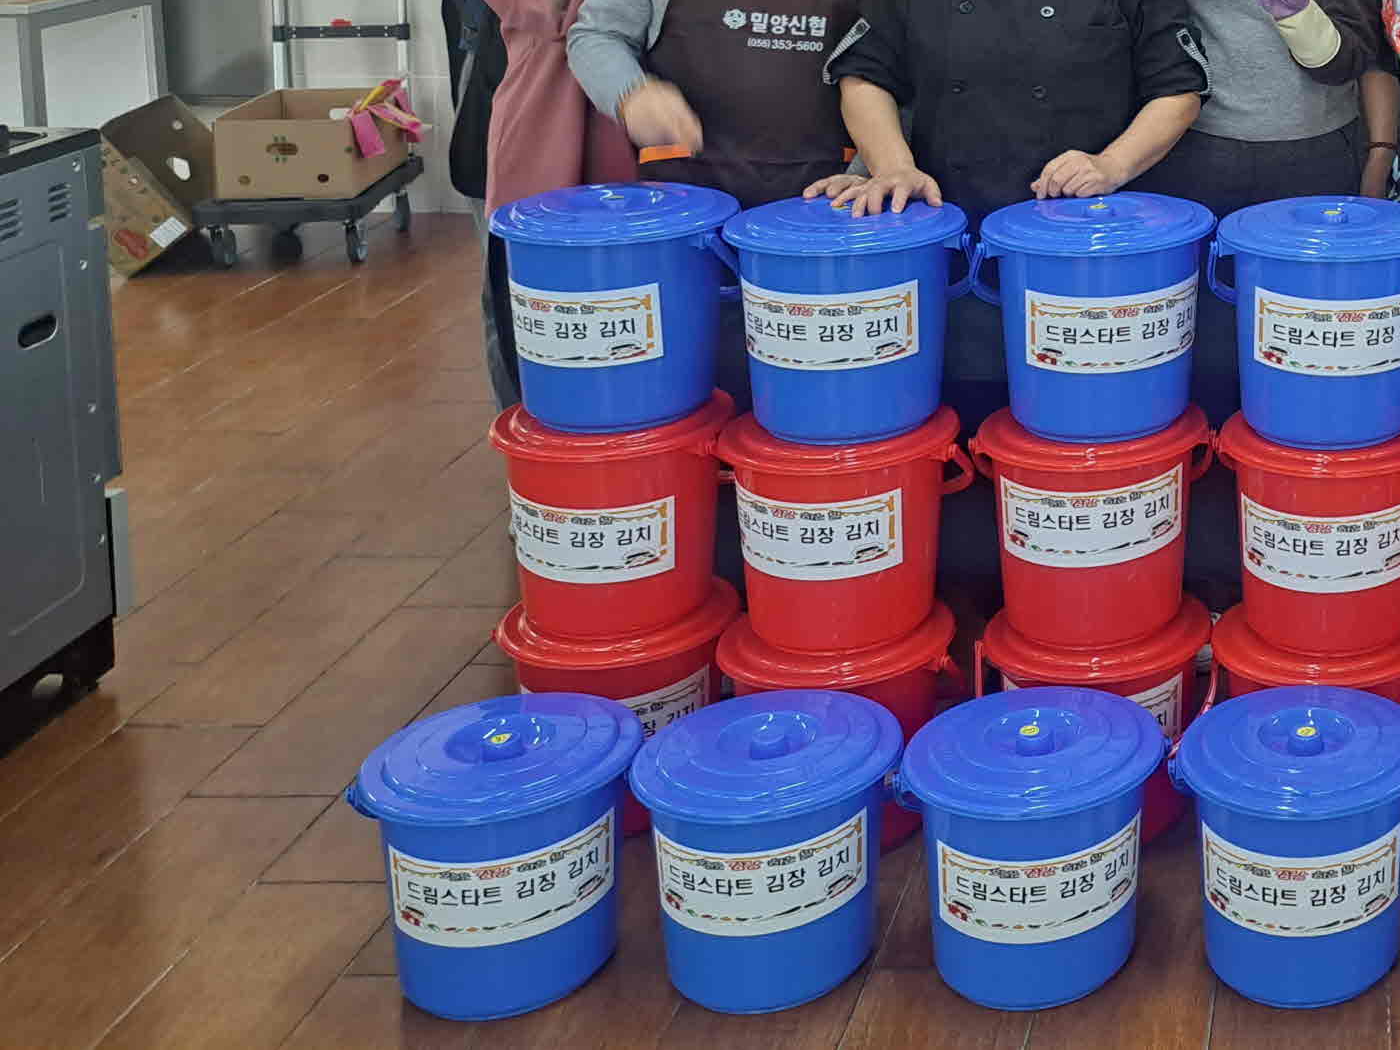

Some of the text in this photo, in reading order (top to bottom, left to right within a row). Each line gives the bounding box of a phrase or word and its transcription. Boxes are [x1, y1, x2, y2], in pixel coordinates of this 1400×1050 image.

[750, 12, 827, 37] 밀양신협
[515, 314, 636, 339] 스타트 김장 김치
[746, 312, 899, 342] 드림스타트 김장 김치
[1046, 325, 1131, 345] 드림스타트
[1141, 318, 1170, 340] 김장
[1176, 305, 1193, 329] 김치
[1273, 324, 1356, 348] 드림스타트
[1366, 326, 1395, 346] 김장
[1015, 507, 1091, 531] 드림스타트
[1102, 508, 1136, 529] 김장
[1144, 494, 1169, 518] 김치
[569, 530, 606, 549] 김장
[616, 525, 651, 546] 김치
[800, 526, 834, 544] 김장
[846, 519, 879, 541] 김치
[1252, 526, 1325, 556] 드림스타트
[1336, 537, 1369, 556] 김장
[407, 881, 503, 907] 드림스타트
[516, 871, 557, 899] 김장
[568, 846, 599, 880] 김치
[669, 864, 754, 897] 드림스타트
[766, 868, 807, 893] 김장
[818, 846, 849, 877] 김치
[956, 875, 1047, 904] 드림스타트
[1059, 872, 1096, 899] 김장
[1104, 849, 1129, 881] 김치
[1216, 867, 1297, 906] 드림스타트
[1310, 885, 1346, 907] 김장
[1357, 867, 1385, 896] 김치
